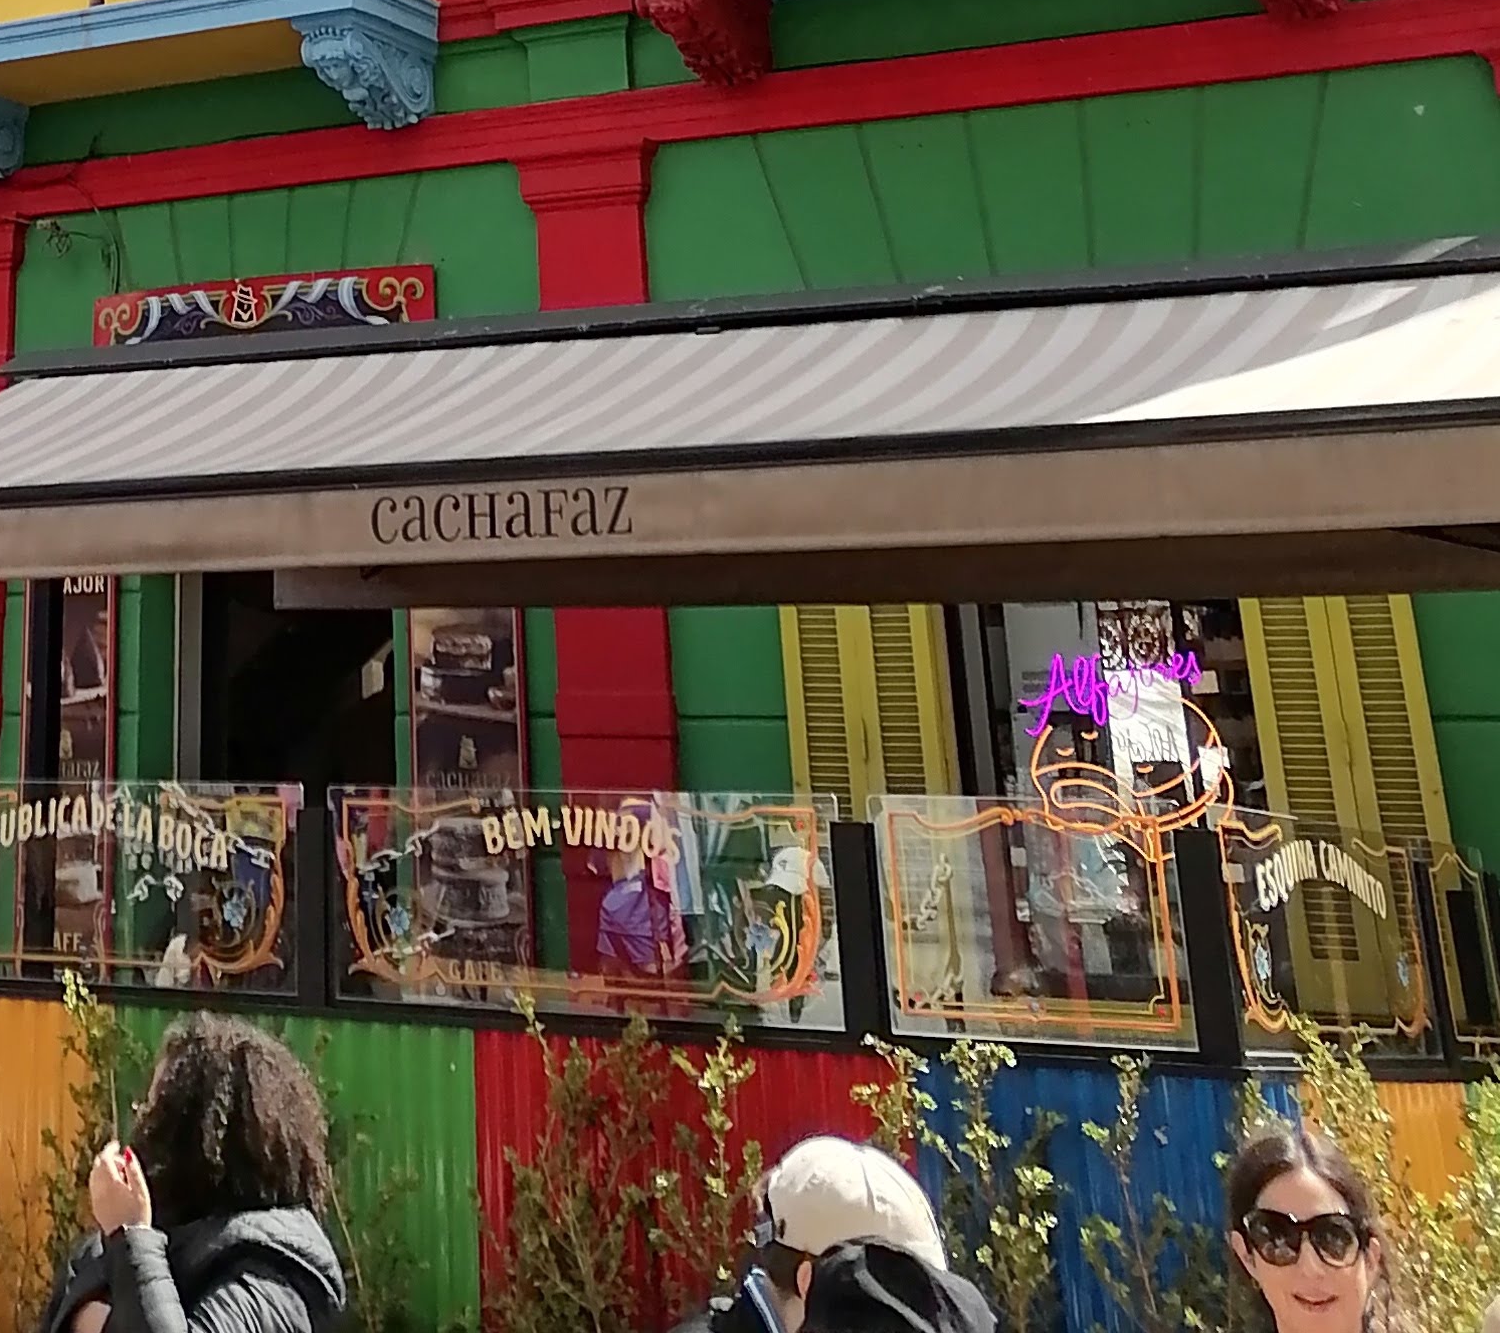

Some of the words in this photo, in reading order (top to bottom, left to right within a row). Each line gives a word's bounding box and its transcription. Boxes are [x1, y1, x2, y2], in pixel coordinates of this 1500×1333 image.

[91, 795, 116, 832] DE
[122, 802, 154, 845] LA
[158, 813, 229, 872] BOCA
[1255, 839, 1318, 912] ESQUINA
[1318, 839, 1387, 920] CAMINITO
